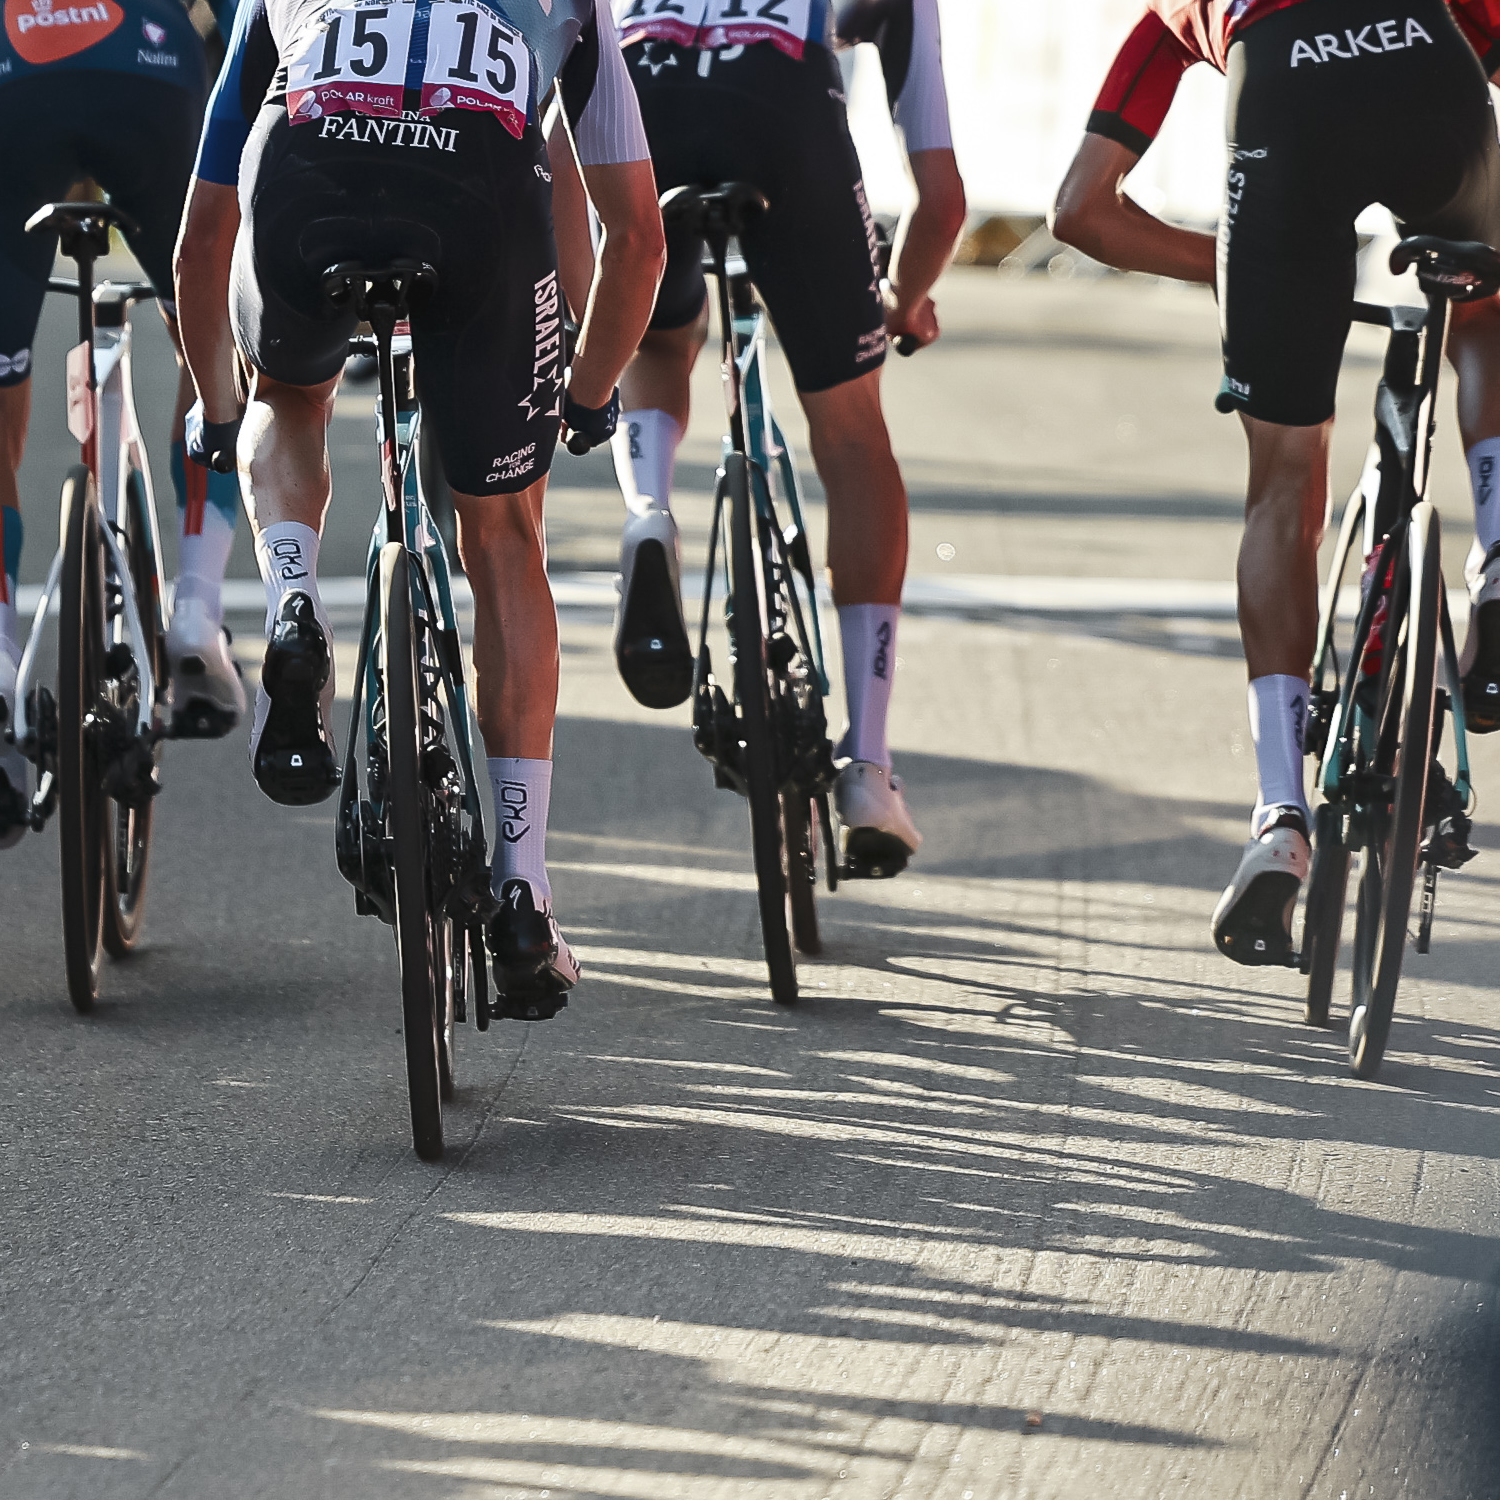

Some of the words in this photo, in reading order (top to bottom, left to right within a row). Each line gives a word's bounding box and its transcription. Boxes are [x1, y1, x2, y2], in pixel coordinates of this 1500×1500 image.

[17, 1, 110, 34] postnl
[313, 8, 390, 81] 15
[448, 11, 518, 95] 15
[1290, 17, 1433, 68] ARKEA
[366, 92, 395, 106] kraft
[319, 115, 460, 152] FANTINI
[533, 270, 563, 375] ISRAEL
[485, 457, 536, 483] CHANGE
[492, 442, 537, 468] RACING
